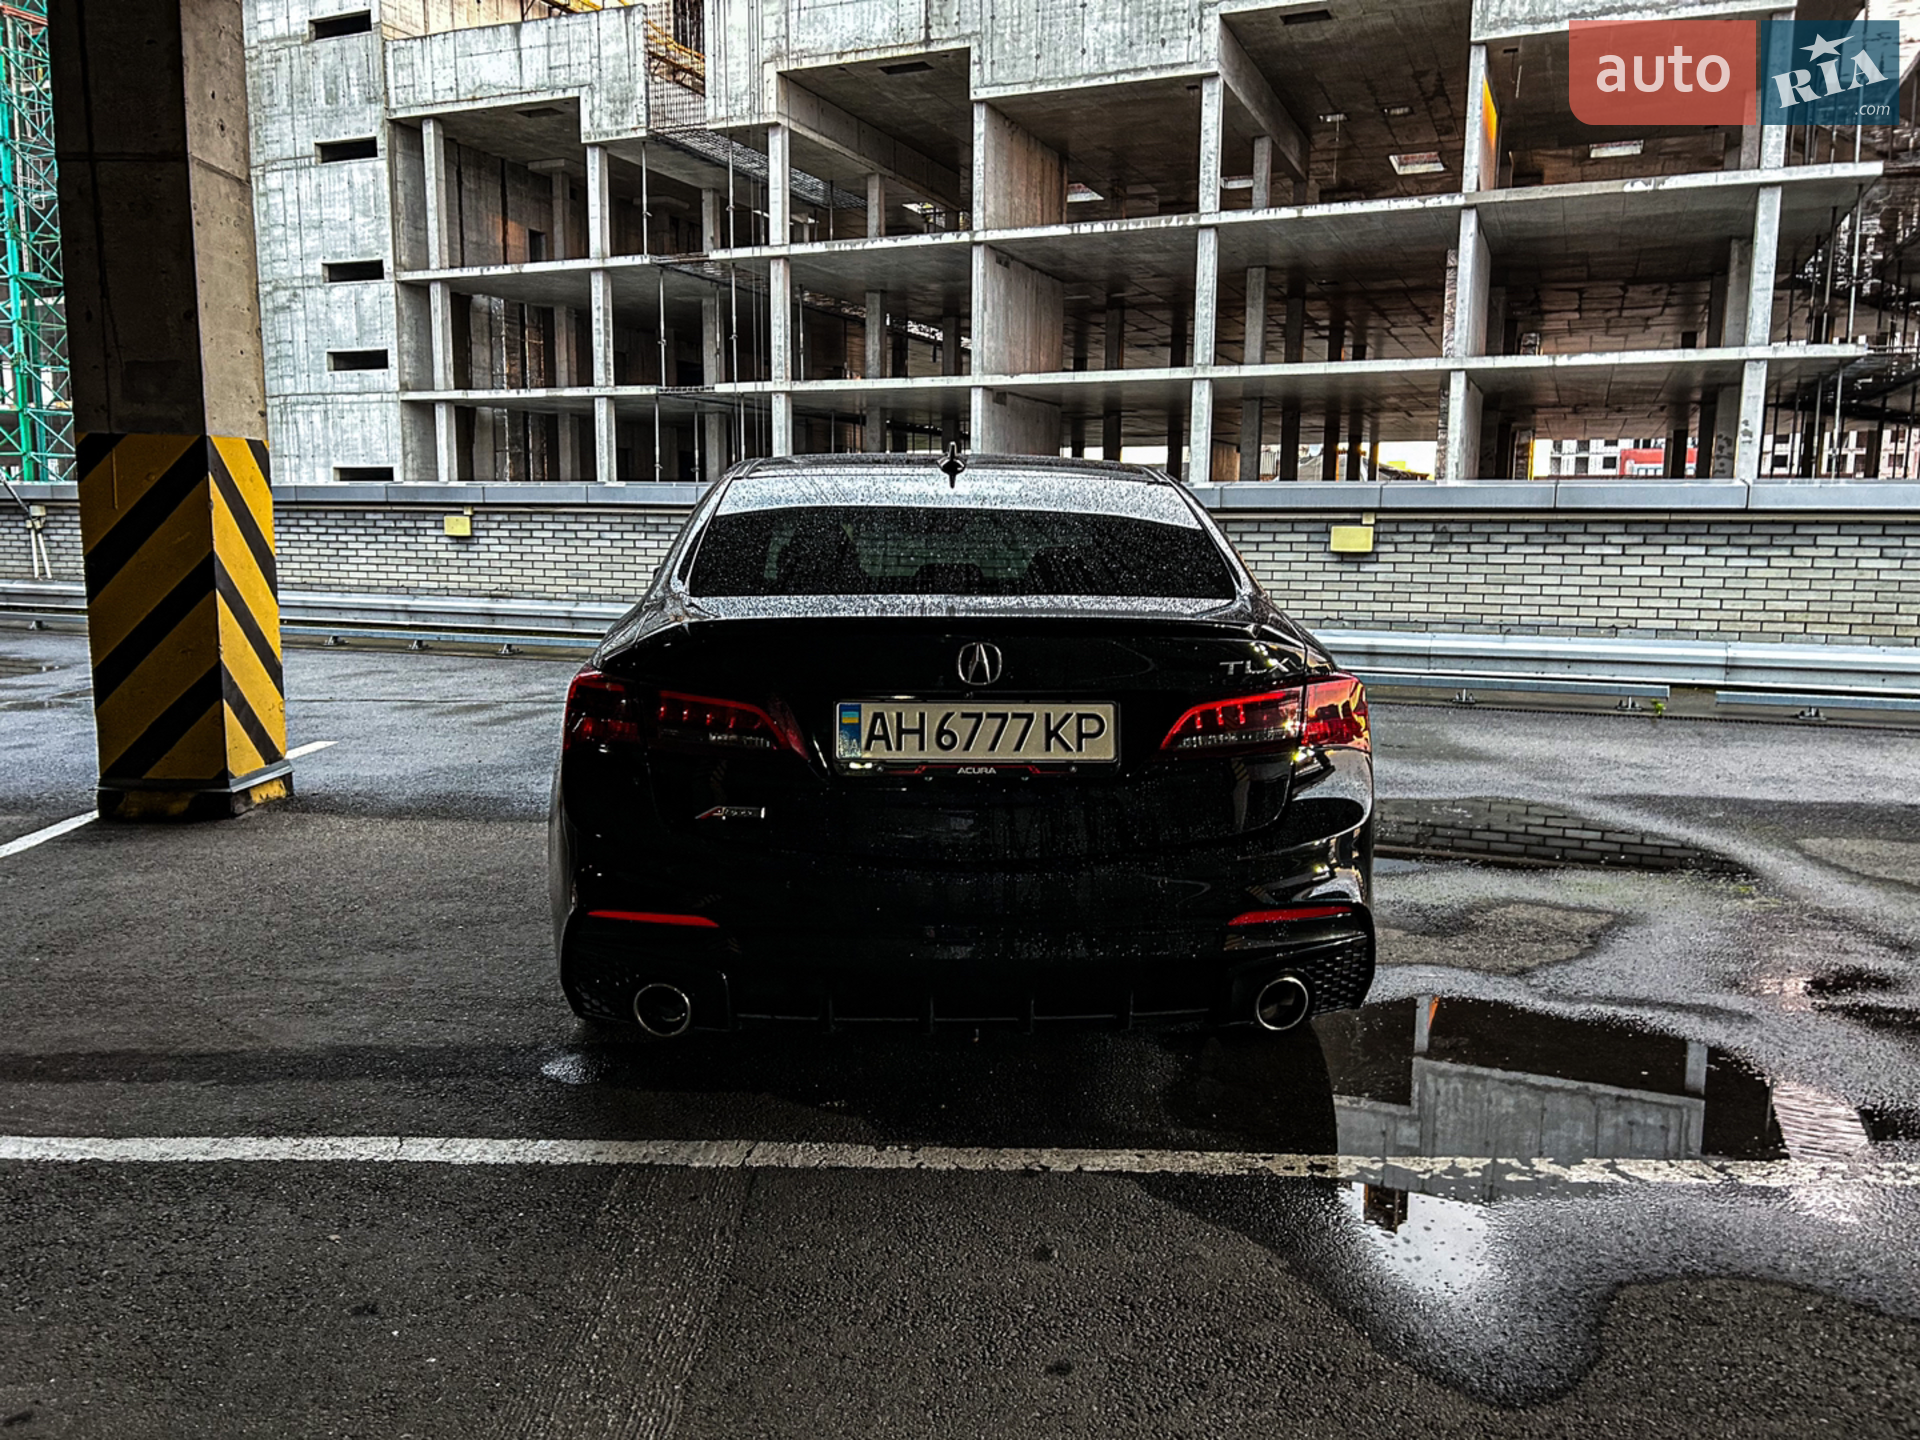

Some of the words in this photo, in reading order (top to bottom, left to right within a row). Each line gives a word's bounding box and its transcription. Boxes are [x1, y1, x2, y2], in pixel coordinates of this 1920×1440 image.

[1219, 657, 1289, 675] TLX
[864, 711, 928, 752] AH
[935, 711, 1037, 752] 6777
[1044, 711, 1107, 752] KP
[956, 766, 997, 775] ACURA
